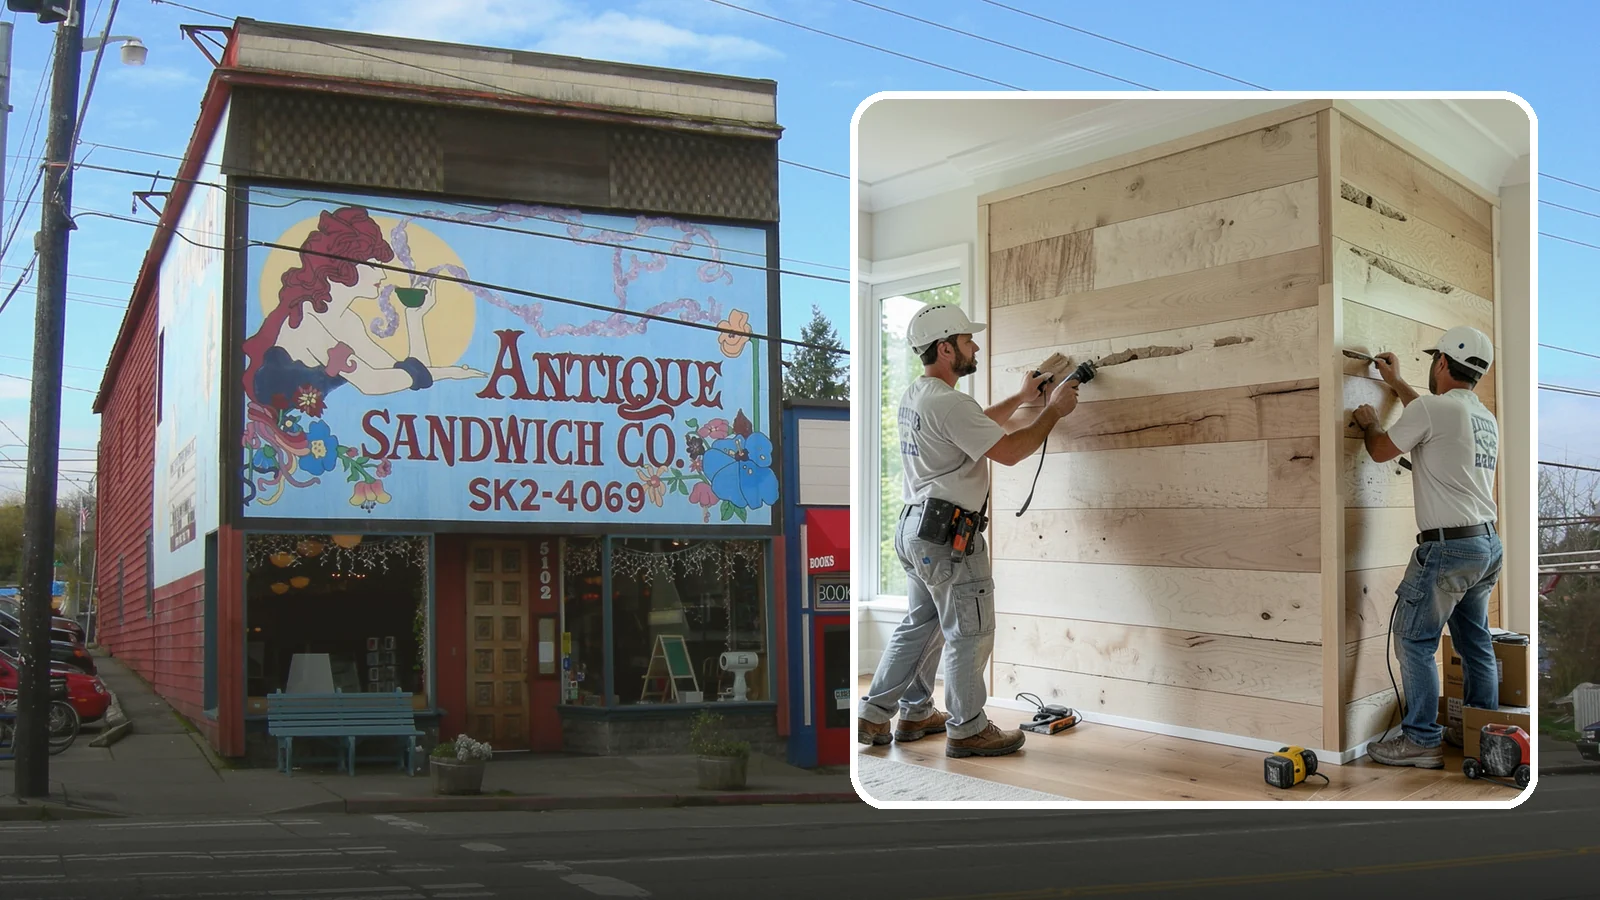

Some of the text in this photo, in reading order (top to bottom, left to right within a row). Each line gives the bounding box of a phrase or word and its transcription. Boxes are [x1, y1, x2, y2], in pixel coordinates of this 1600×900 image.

[475, 328, 724, 420] ANTIQUE
[361, 408, 685, 469] SANDWICH CO.
[468, 476, 646, 513] SK2-4069
[540, 541, 551, 599] 5102
[809, 555, 835, 569] BOOKS
